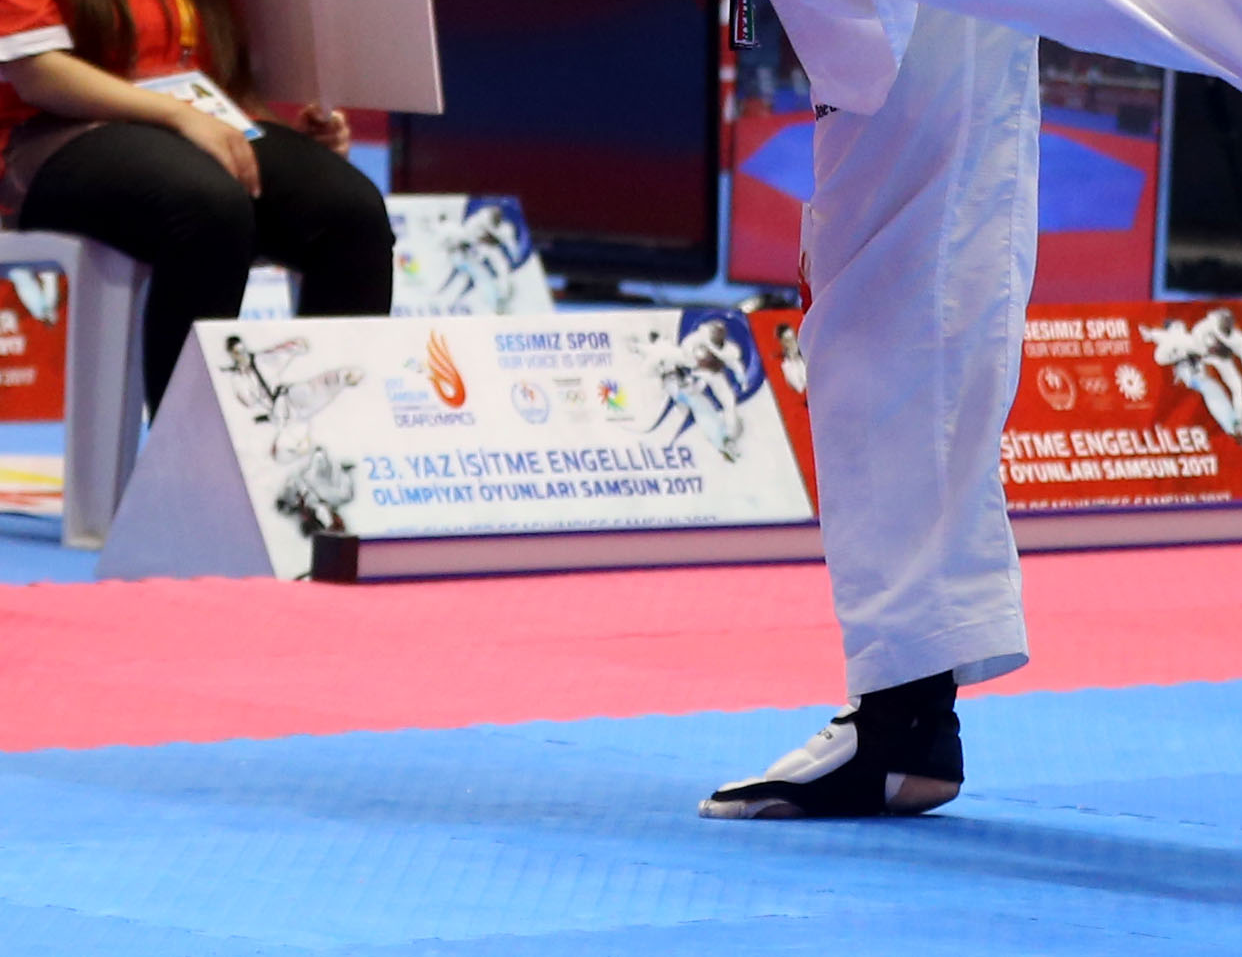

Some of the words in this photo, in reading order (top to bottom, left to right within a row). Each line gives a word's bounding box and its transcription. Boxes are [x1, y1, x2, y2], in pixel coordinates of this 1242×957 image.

[566, 330, 611, 350] SPOR
[406, 454, 455, 479] YAZ
[1181, 455, 1219, 477] 2017
[582, 477, 660, 498] SAMSUN
[663, 476, 704, 496] 2017
